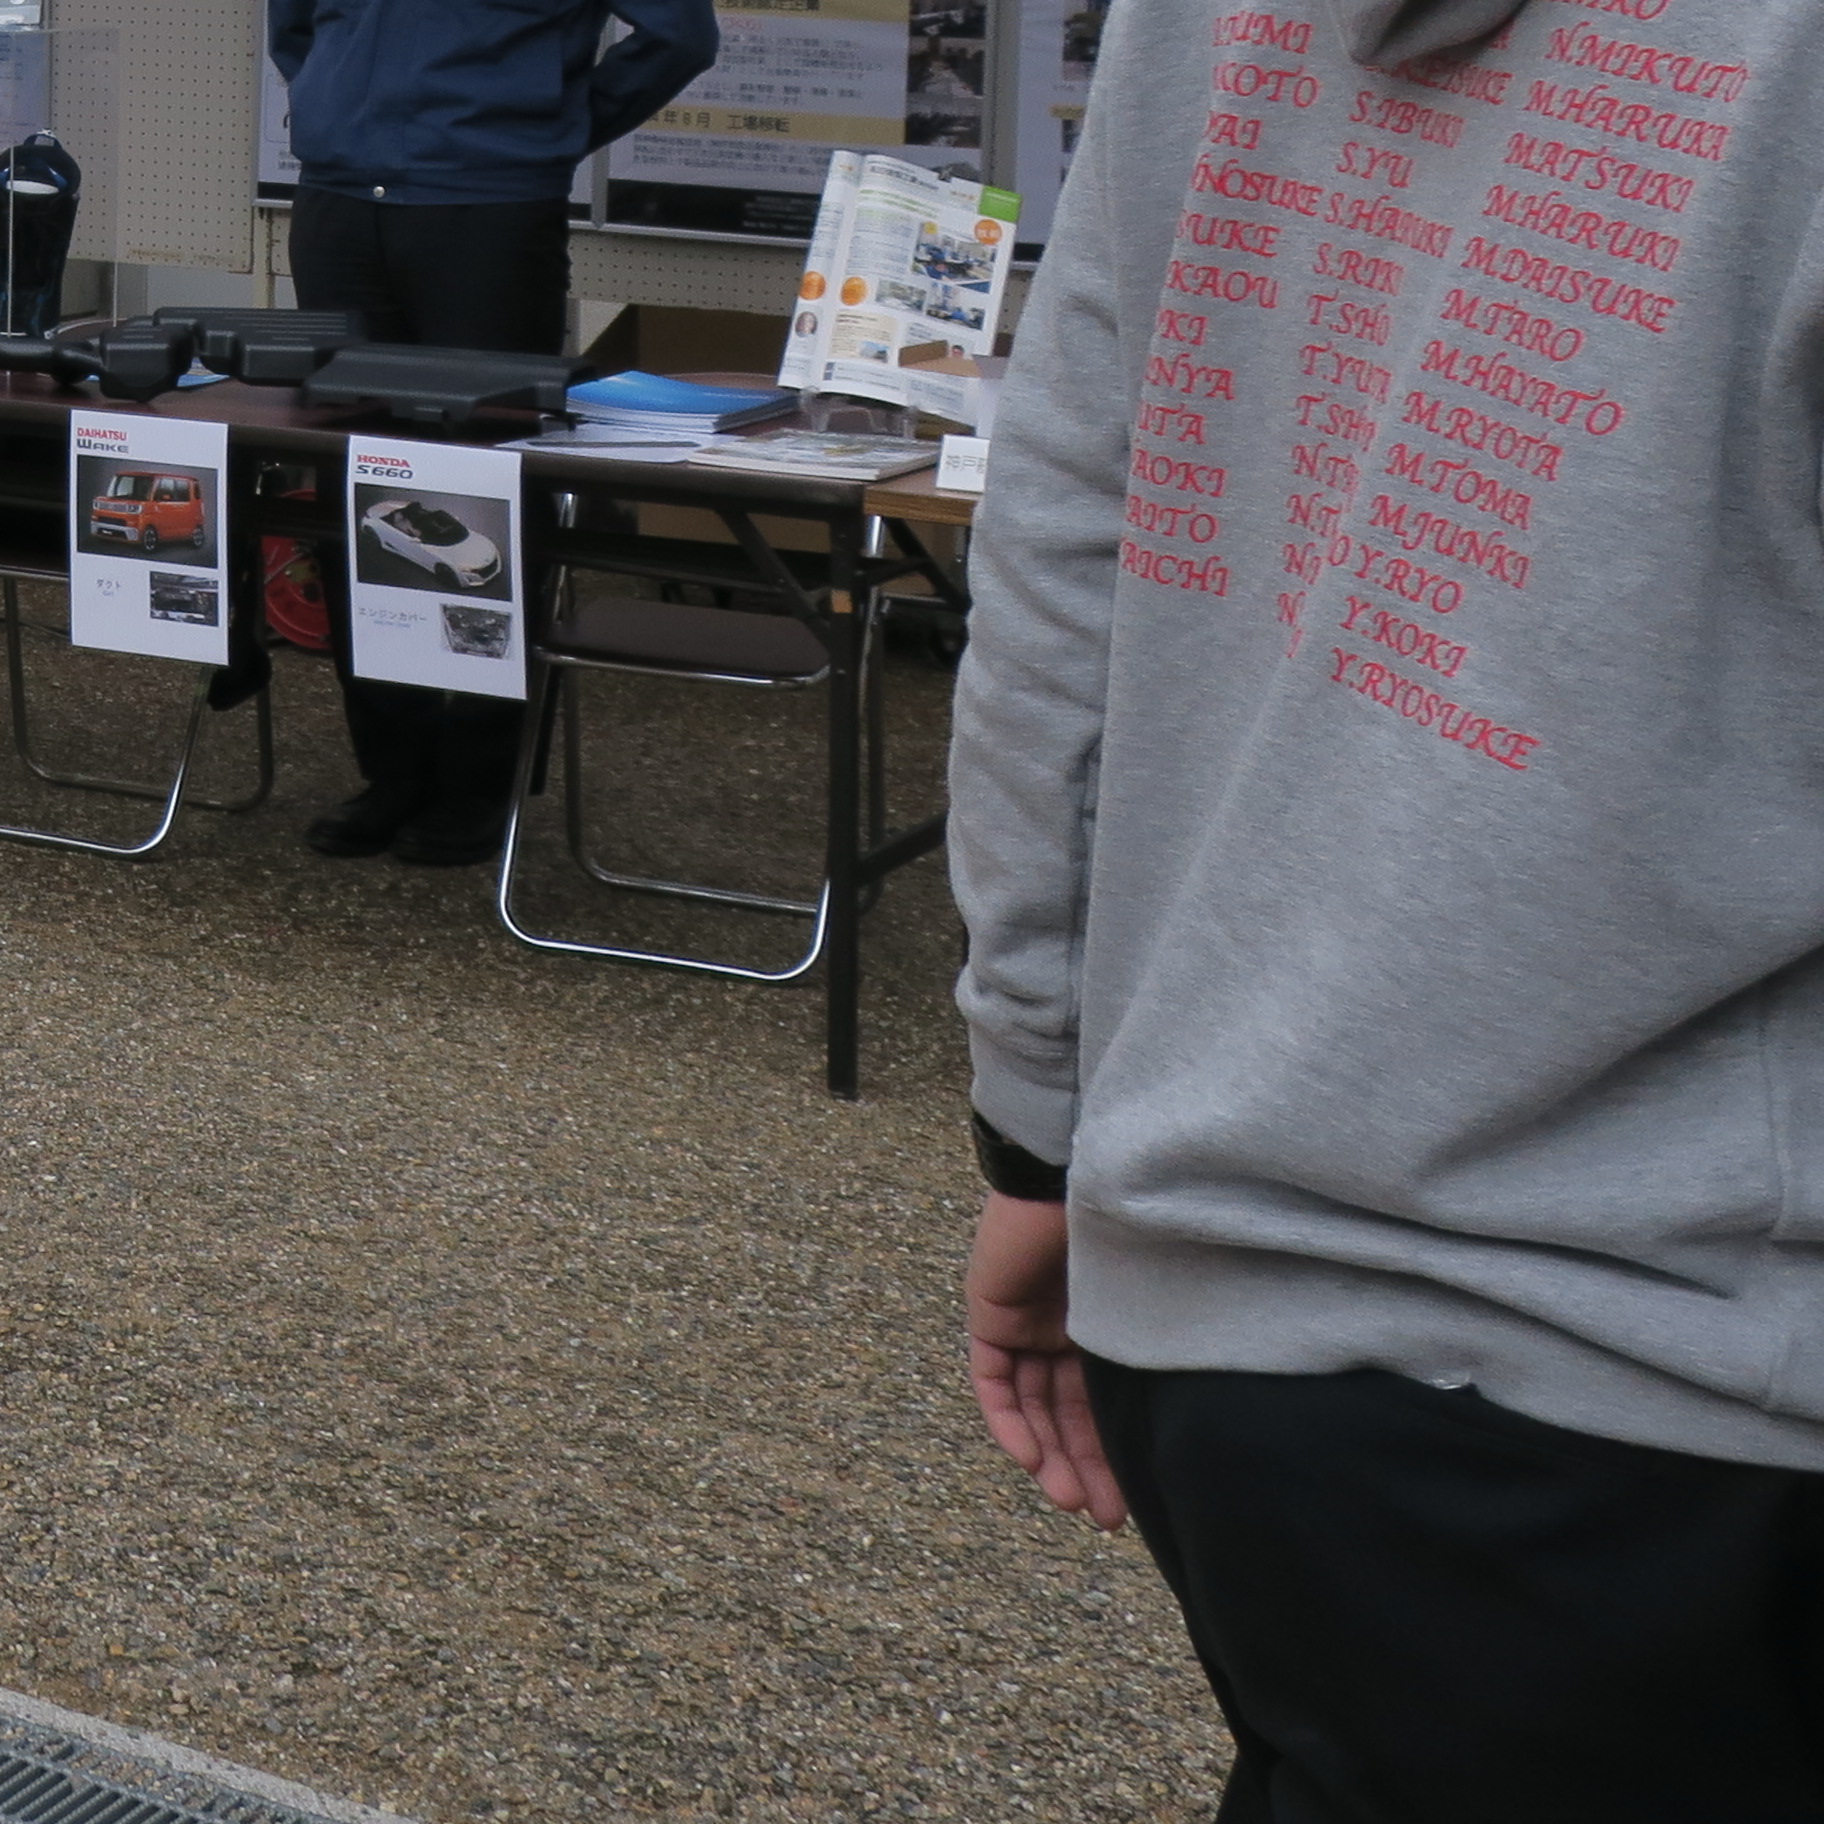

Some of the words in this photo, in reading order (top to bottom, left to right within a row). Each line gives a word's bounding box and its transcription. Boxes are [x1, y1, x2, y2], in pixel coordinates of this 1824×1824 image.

[76, 426, 127, 442] DAIHATSU
[76, 438, 129, 454] WAKE
[357, 455, 410, 469] HONDA
[355, 464, 414, 480] S660
[1354, 543, 1465, 615] Y.RYO
[1339, 595, 1467, 678] Y.KOKI
[1329, 647, 1541, 772] Y.RYOSUKE
